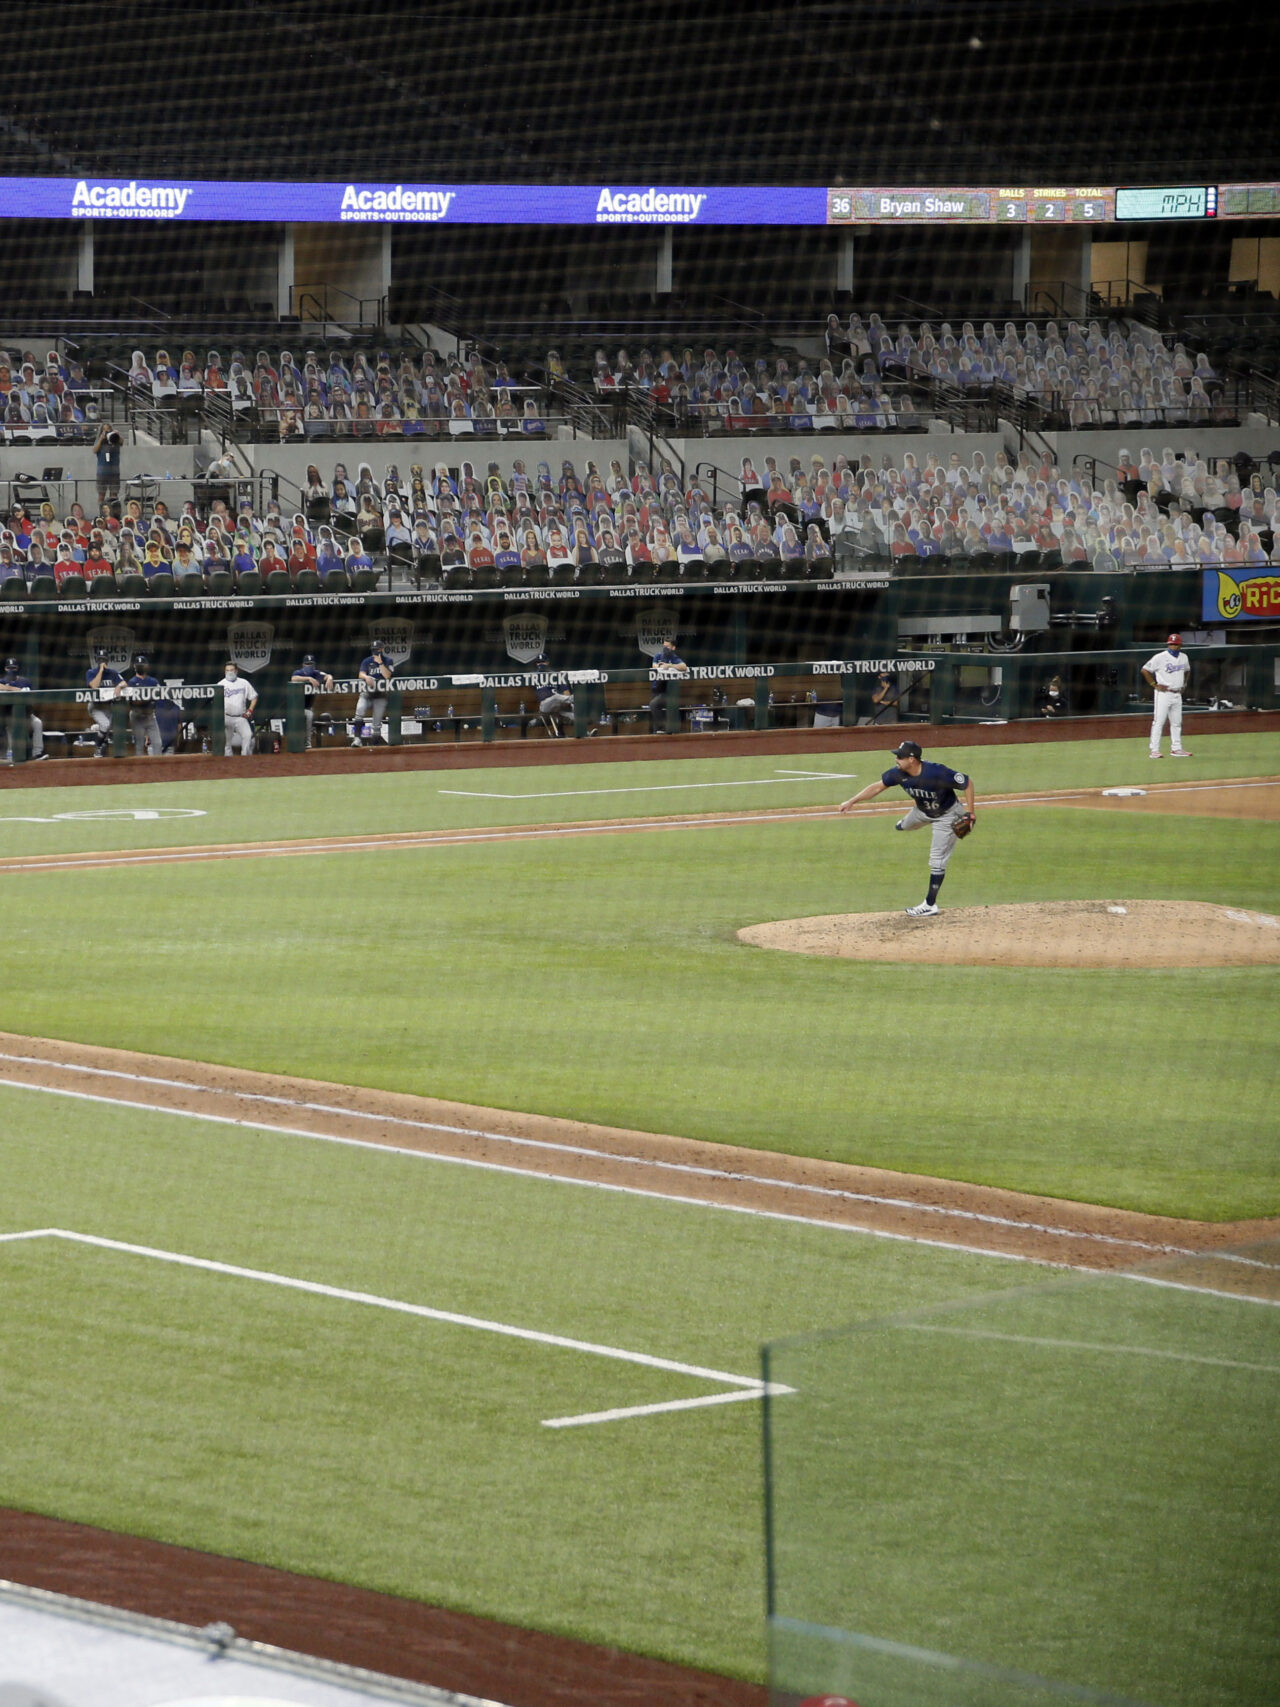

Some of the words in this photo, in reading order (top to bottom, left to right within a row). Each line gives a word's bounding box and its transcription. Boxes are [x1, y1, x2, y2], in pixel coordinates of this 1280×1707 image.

[72, 181, 189, 215] Academy
[999, 190, 1024, 198] BALLS
[1034, 190, 1065, 198] STRIKES
[1076, 189, 1102, 197] TOTAL
[340, 185, 450, 217] Academy
[596, 188, 703, 219] Academy
[832, 199, 849, 213] 36
[880, 199, 920, 216] Bryan
[925, 199, 964, 213] Shaw
[1006, 204, 1015, 217] 3
[1045, 204, 1054, 217] 2
[1084, 204, 1093, 217] 5
[635, 588, 660, 596] TRUCK
[86, 603, 113, 611] TRUCK
[201, 601, 227, 609] TRUCK
[234, 632, 267, 641] DALLAS
[510, 632, 541, 640] TRUCK
[234, 641, 267, 650] TRUCK
[510, 641, 540, 650] WORLD
[235, 650, 267, 659] WORLD
[692, 666, 733, 678] TRUCK
[735, 666, 774, 677] WORLD
[812, 663, 853, 674] DALLAS
[855, 661, 895, 673] TRUCK
[897, 660, 936, 672] WORLD
[396, 679, 437, 691] WORLD
[479, 676, 521, 687] DALLAS
[523, 672, 566, 686] TRUCK
[172, 687, 214, 700] WORLD
[924, 800, 939, 810] 36
